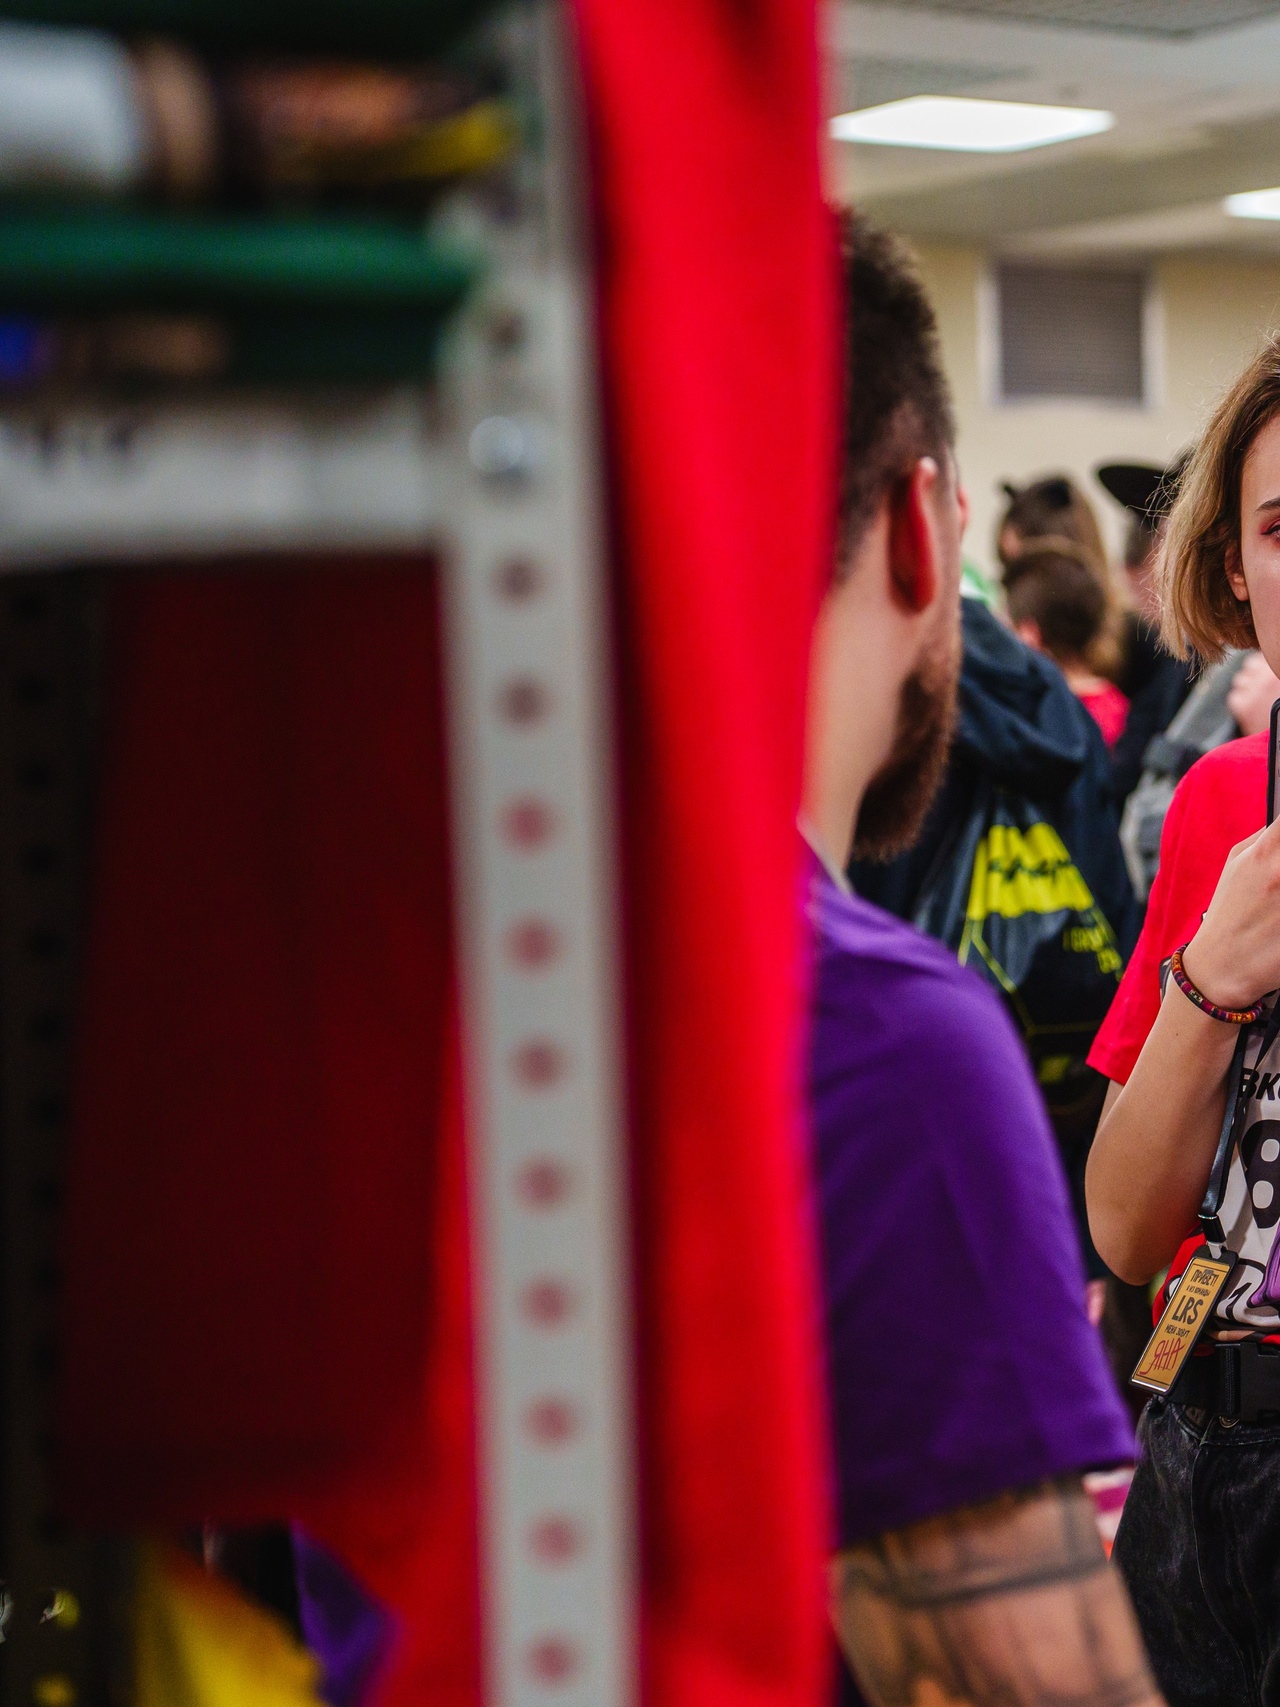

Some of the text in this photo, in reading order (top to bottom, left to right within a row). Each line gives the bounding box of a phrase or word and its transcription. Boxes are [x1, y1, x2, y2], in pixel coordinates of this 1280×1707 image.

[1190, 1269, 1219, 1287] ПРИВЕТ!
[1172, 1295, 1204, 1325] LRS
[1139, 1337, 1186, 1375] ЯНА
